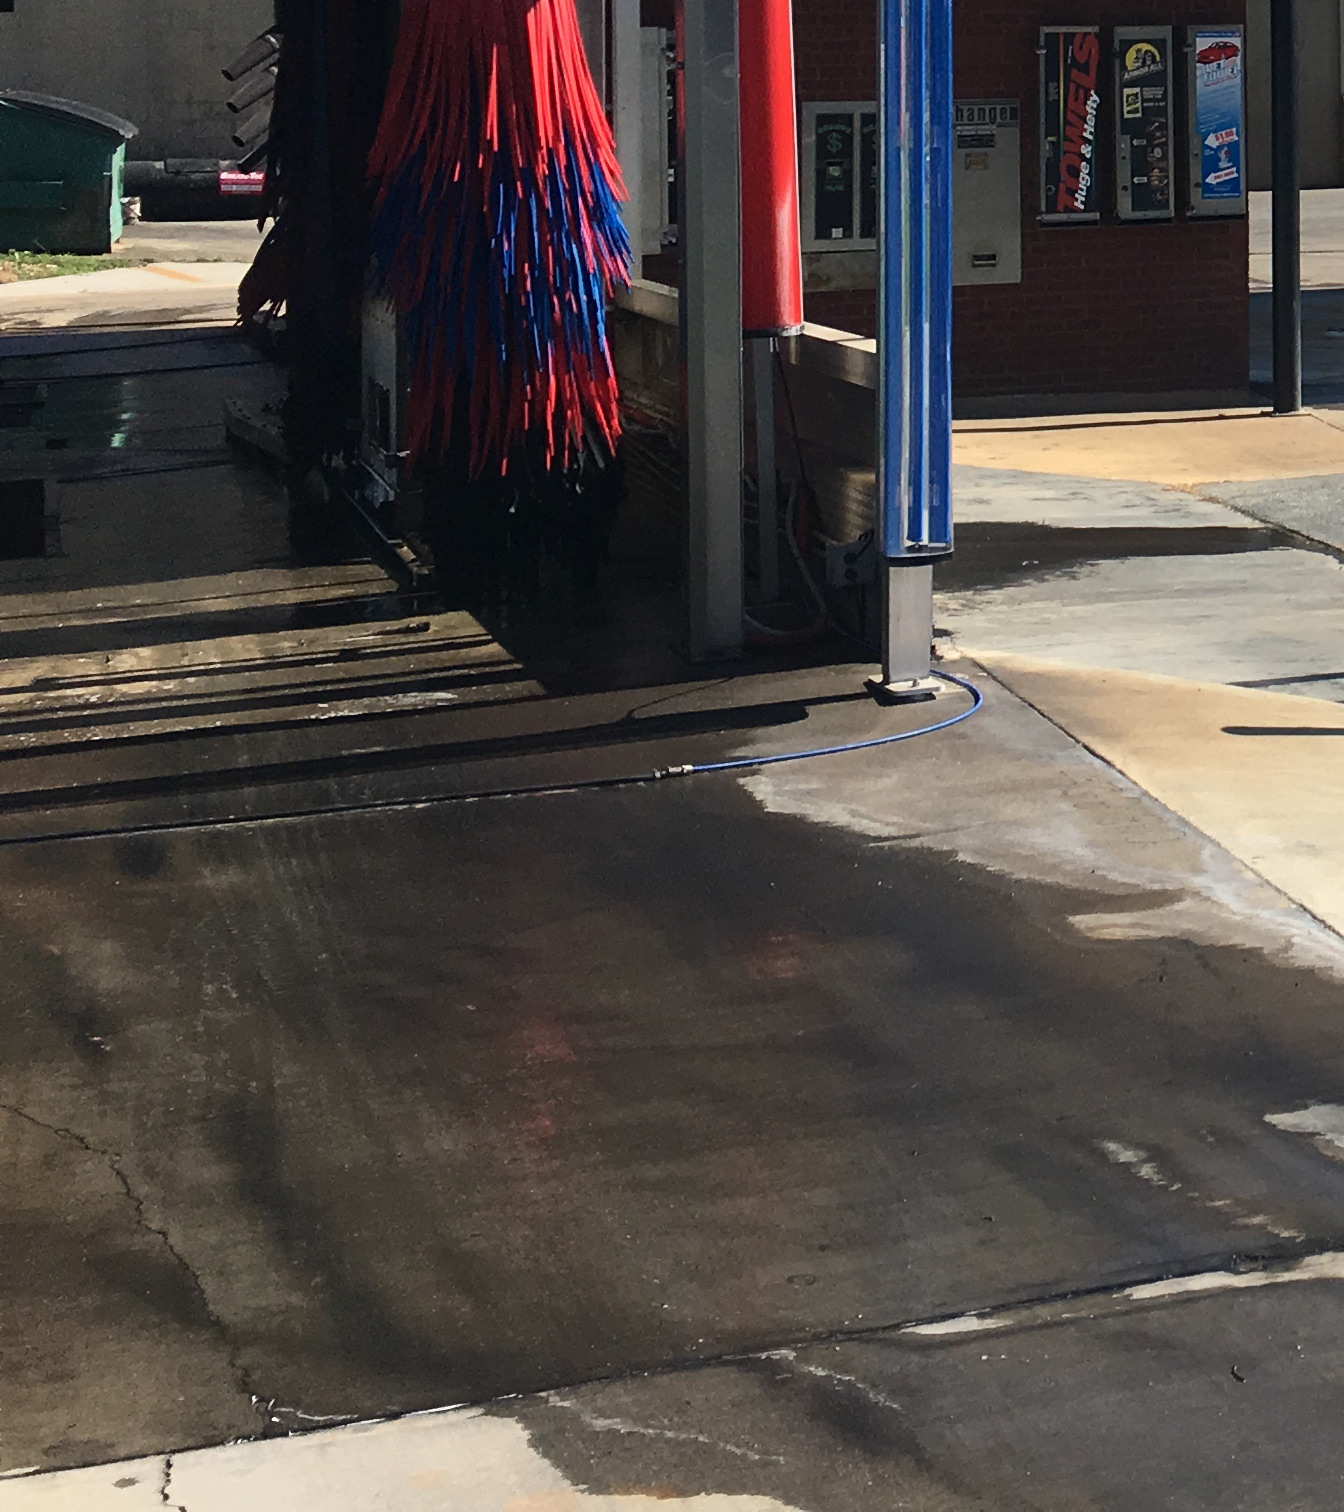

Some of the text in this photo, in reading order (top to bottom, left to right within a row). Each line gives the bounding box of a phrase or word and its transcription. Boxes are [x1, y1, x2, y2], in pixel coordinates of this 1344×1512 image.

[1056, 32, 1100, 213] TOWELS
[1073, 89, 1101, 210] Huge & Hefty
